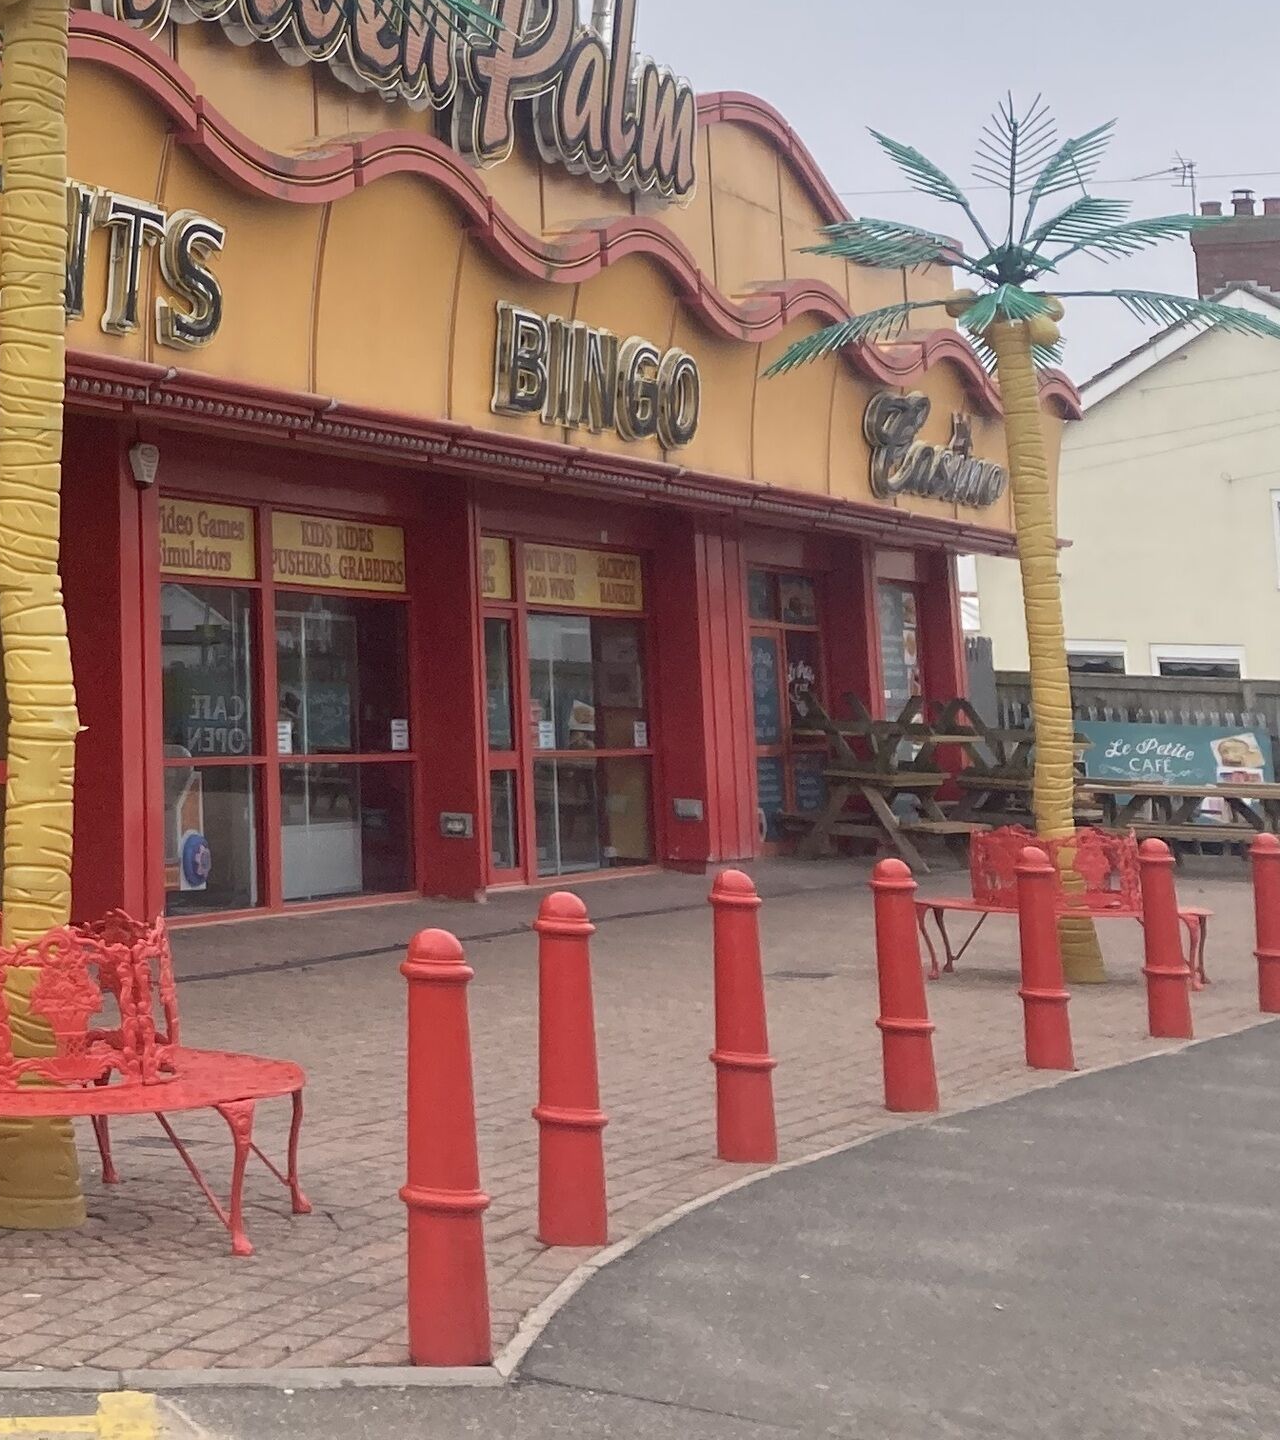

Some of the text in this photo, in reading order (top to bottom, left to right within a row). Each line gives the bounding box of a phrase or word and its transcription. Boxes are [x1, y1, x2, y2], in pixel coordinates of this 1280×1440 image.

[491, 300, 702, 450] BINGO
[160, 505, 245, 541] ideo Games
[301, 520, 375, 553] KIDS RIDES
[339, 555, 404, 585] GRABBERS
[1105, 737, 1195, 761] Le Petite
[1129, 756, 1173, 774] CAFÉ
